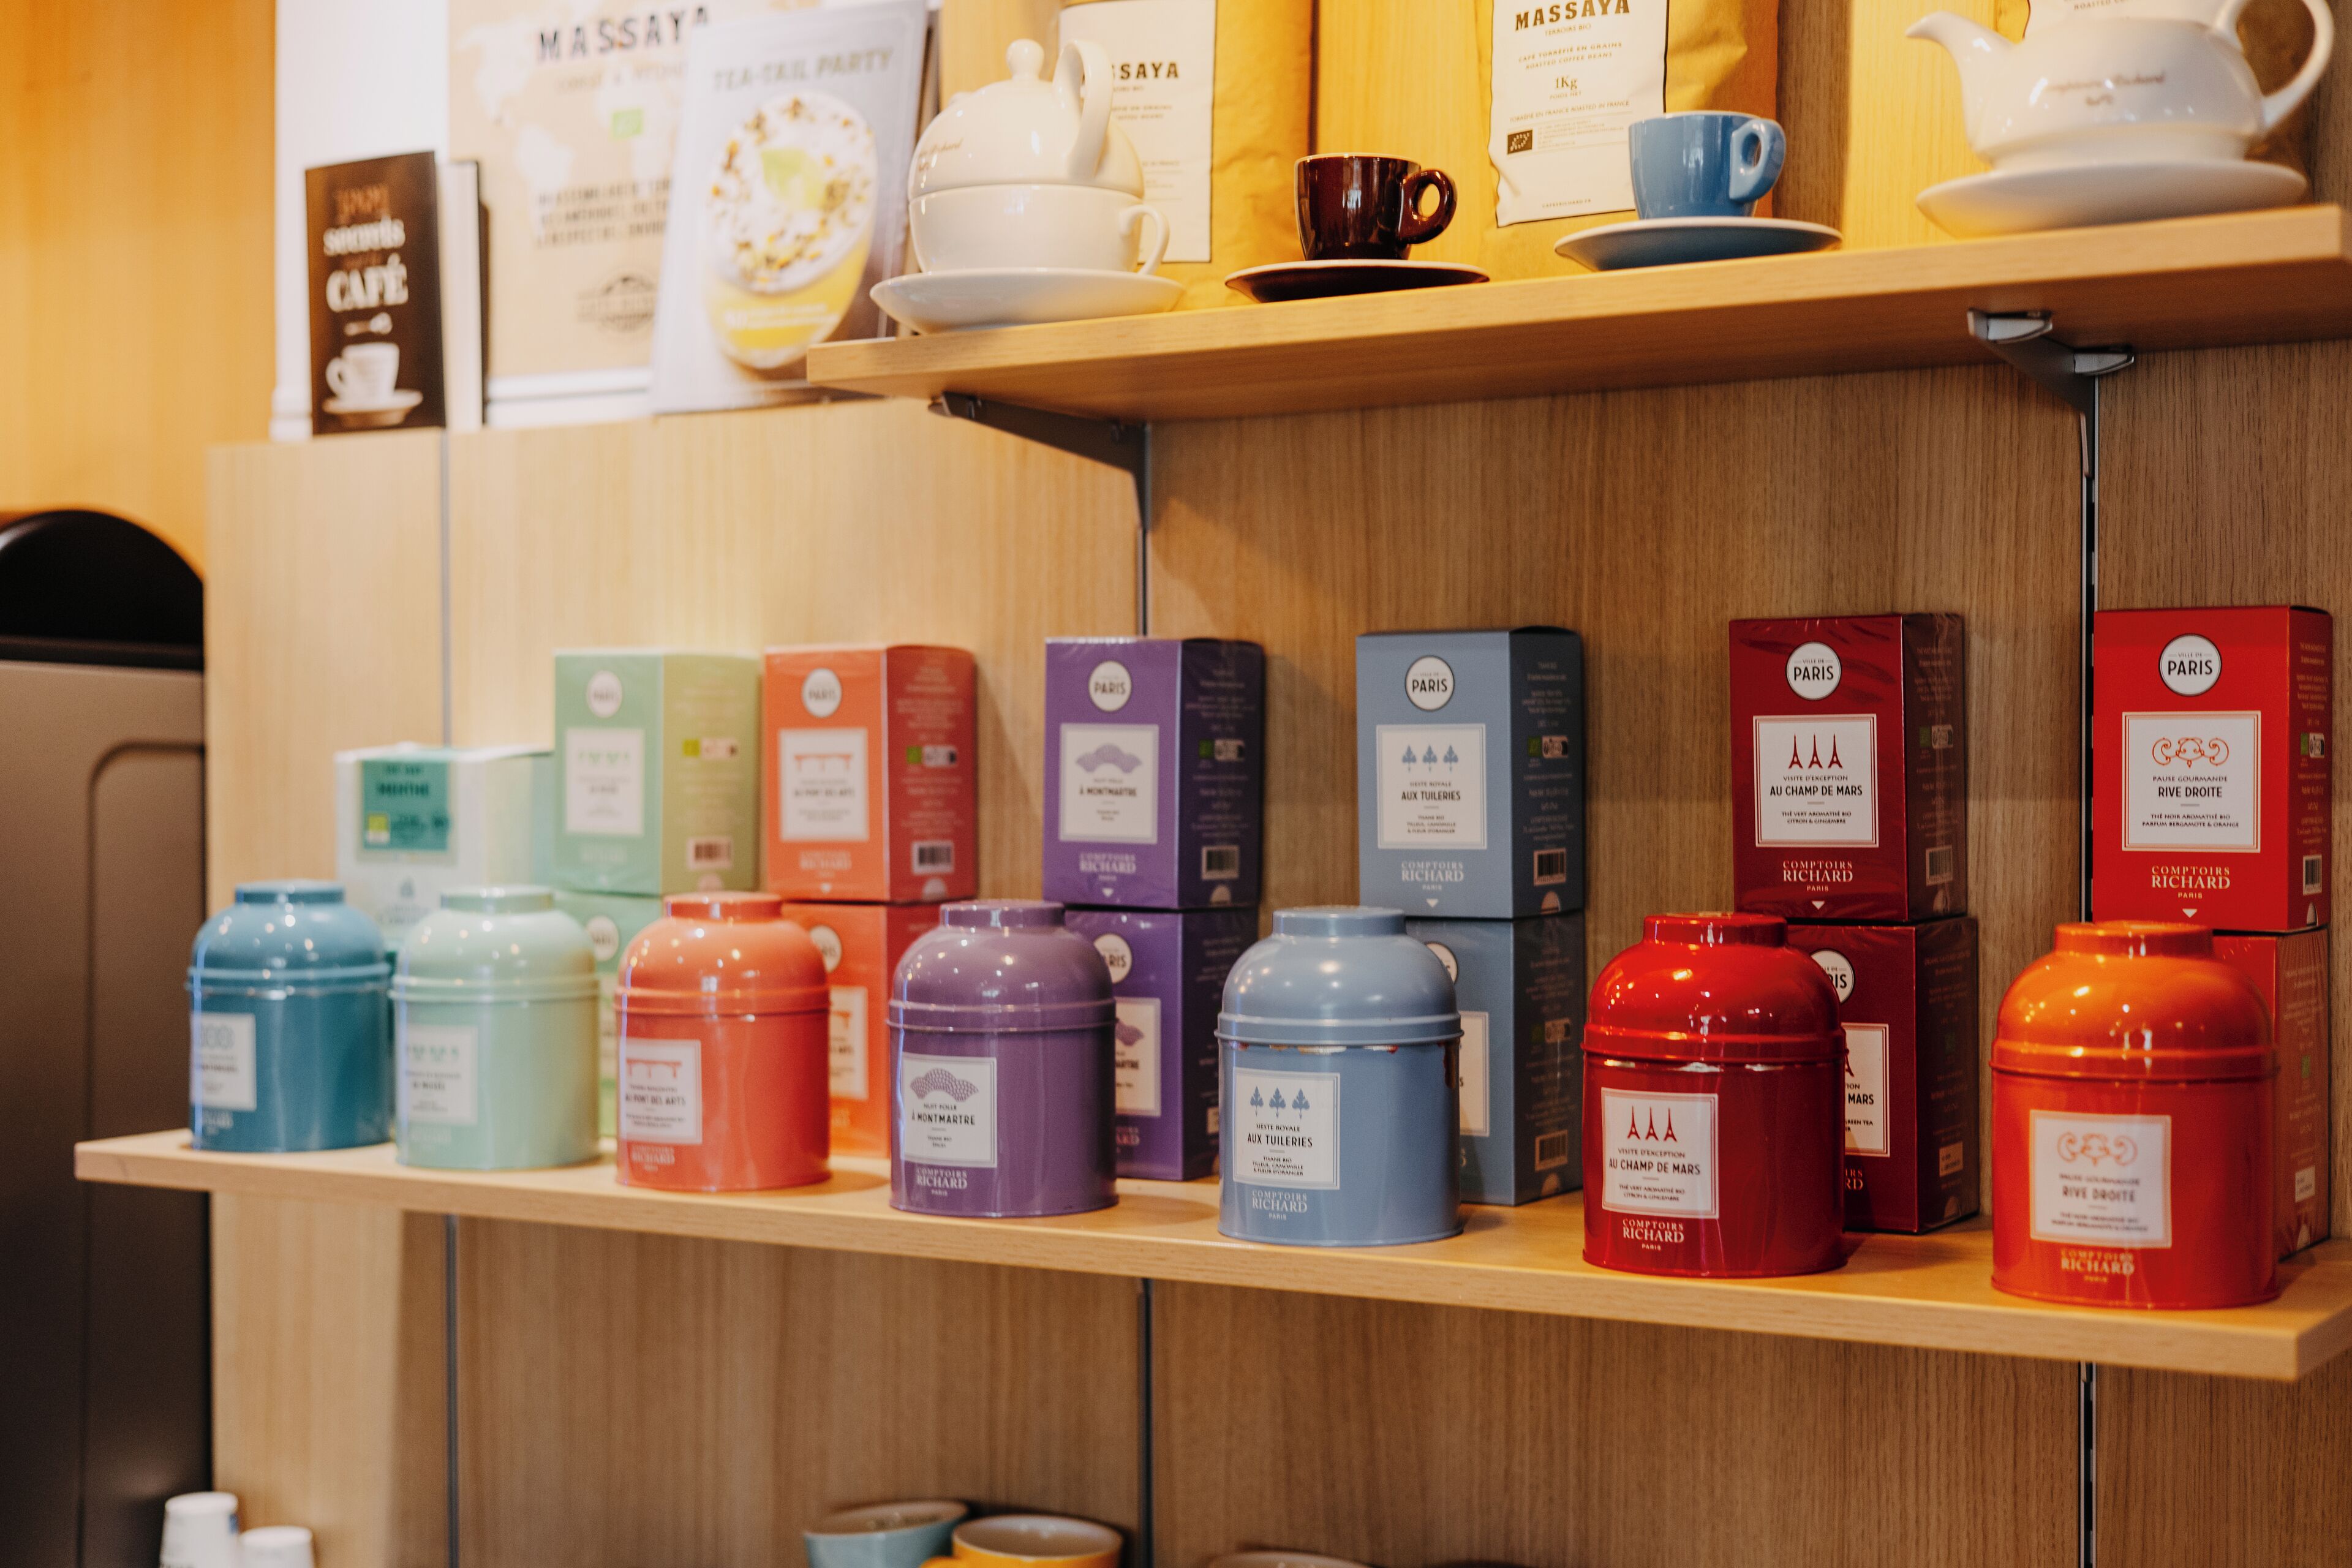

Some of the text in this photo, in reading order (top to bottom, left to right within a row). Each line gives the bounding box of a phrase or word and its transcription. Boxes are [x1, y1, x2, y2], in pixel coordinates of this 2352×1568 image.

[1515, 0, 1630, 31] MASSAYA
[538, 6, 710, 61] MASSAYA
[816, 47, 894, 79] PARTY
[1112, 61, 1180, 80] SAYA
[1556, 76, 1578, 89] 1Kg
[326, 252, 409, 312] CAFÉ
[1793, 666, 1834, 681] PARIS
[2168, 660, 2214, 676] PARIS
[1094, 681, 1126, 695] PARIS
[1412, 678, 1448, 693] PARIS
[1401, 790, 1461, 802] AUX TUILERIES
[1770, 785, 1863, 796] AU CHAMP DE MARS
[2158, 786, 2223, 797] RIVE DROITE
[1079, 861, 1137, 874] RICHARD
[1783, 860, 1853, 870] COMPTOIRS
[2152, 865, 2231, 876] COMPTOIRS
[1401, 870, 1464, 882] RICHARD
[1783, 870, 1853, 883] RICHARD
[2152, 875, 2231, 889] RICHARD
[1847, 1092, 1874, 1105] MARS
[918, 1112, 975, 1126] MONTMARTRE
[1275, 1124, 1301, 1133] ROYALE
[1248, 1133, 1313, 1148] AUX TUILERIES
[1618, 1148, 1686, 1159] VISITE D'EXCEPTION
[916, 1167, 968, 1177] COMPTOIRS
[1609, 1158, 1701, 1176] AU CHAMP DE MARS
[916, 1175, 968, 1189] RICHARD
[1252, 1190, 1308, 1202] COMPTOIRS
[2063, 1185, 2136, 1202] RIVE DROITE
[1252, 1198, 1308, 1213] RICHARD
[1268, 1212, 1287, 1221] PARIS
[1623, 1218, 1684, 1231] COMPTOIRS
[1623, 1226, 1685, 1243] RICHARD
[2060, 1257, 2135, 1276] RICHARD
